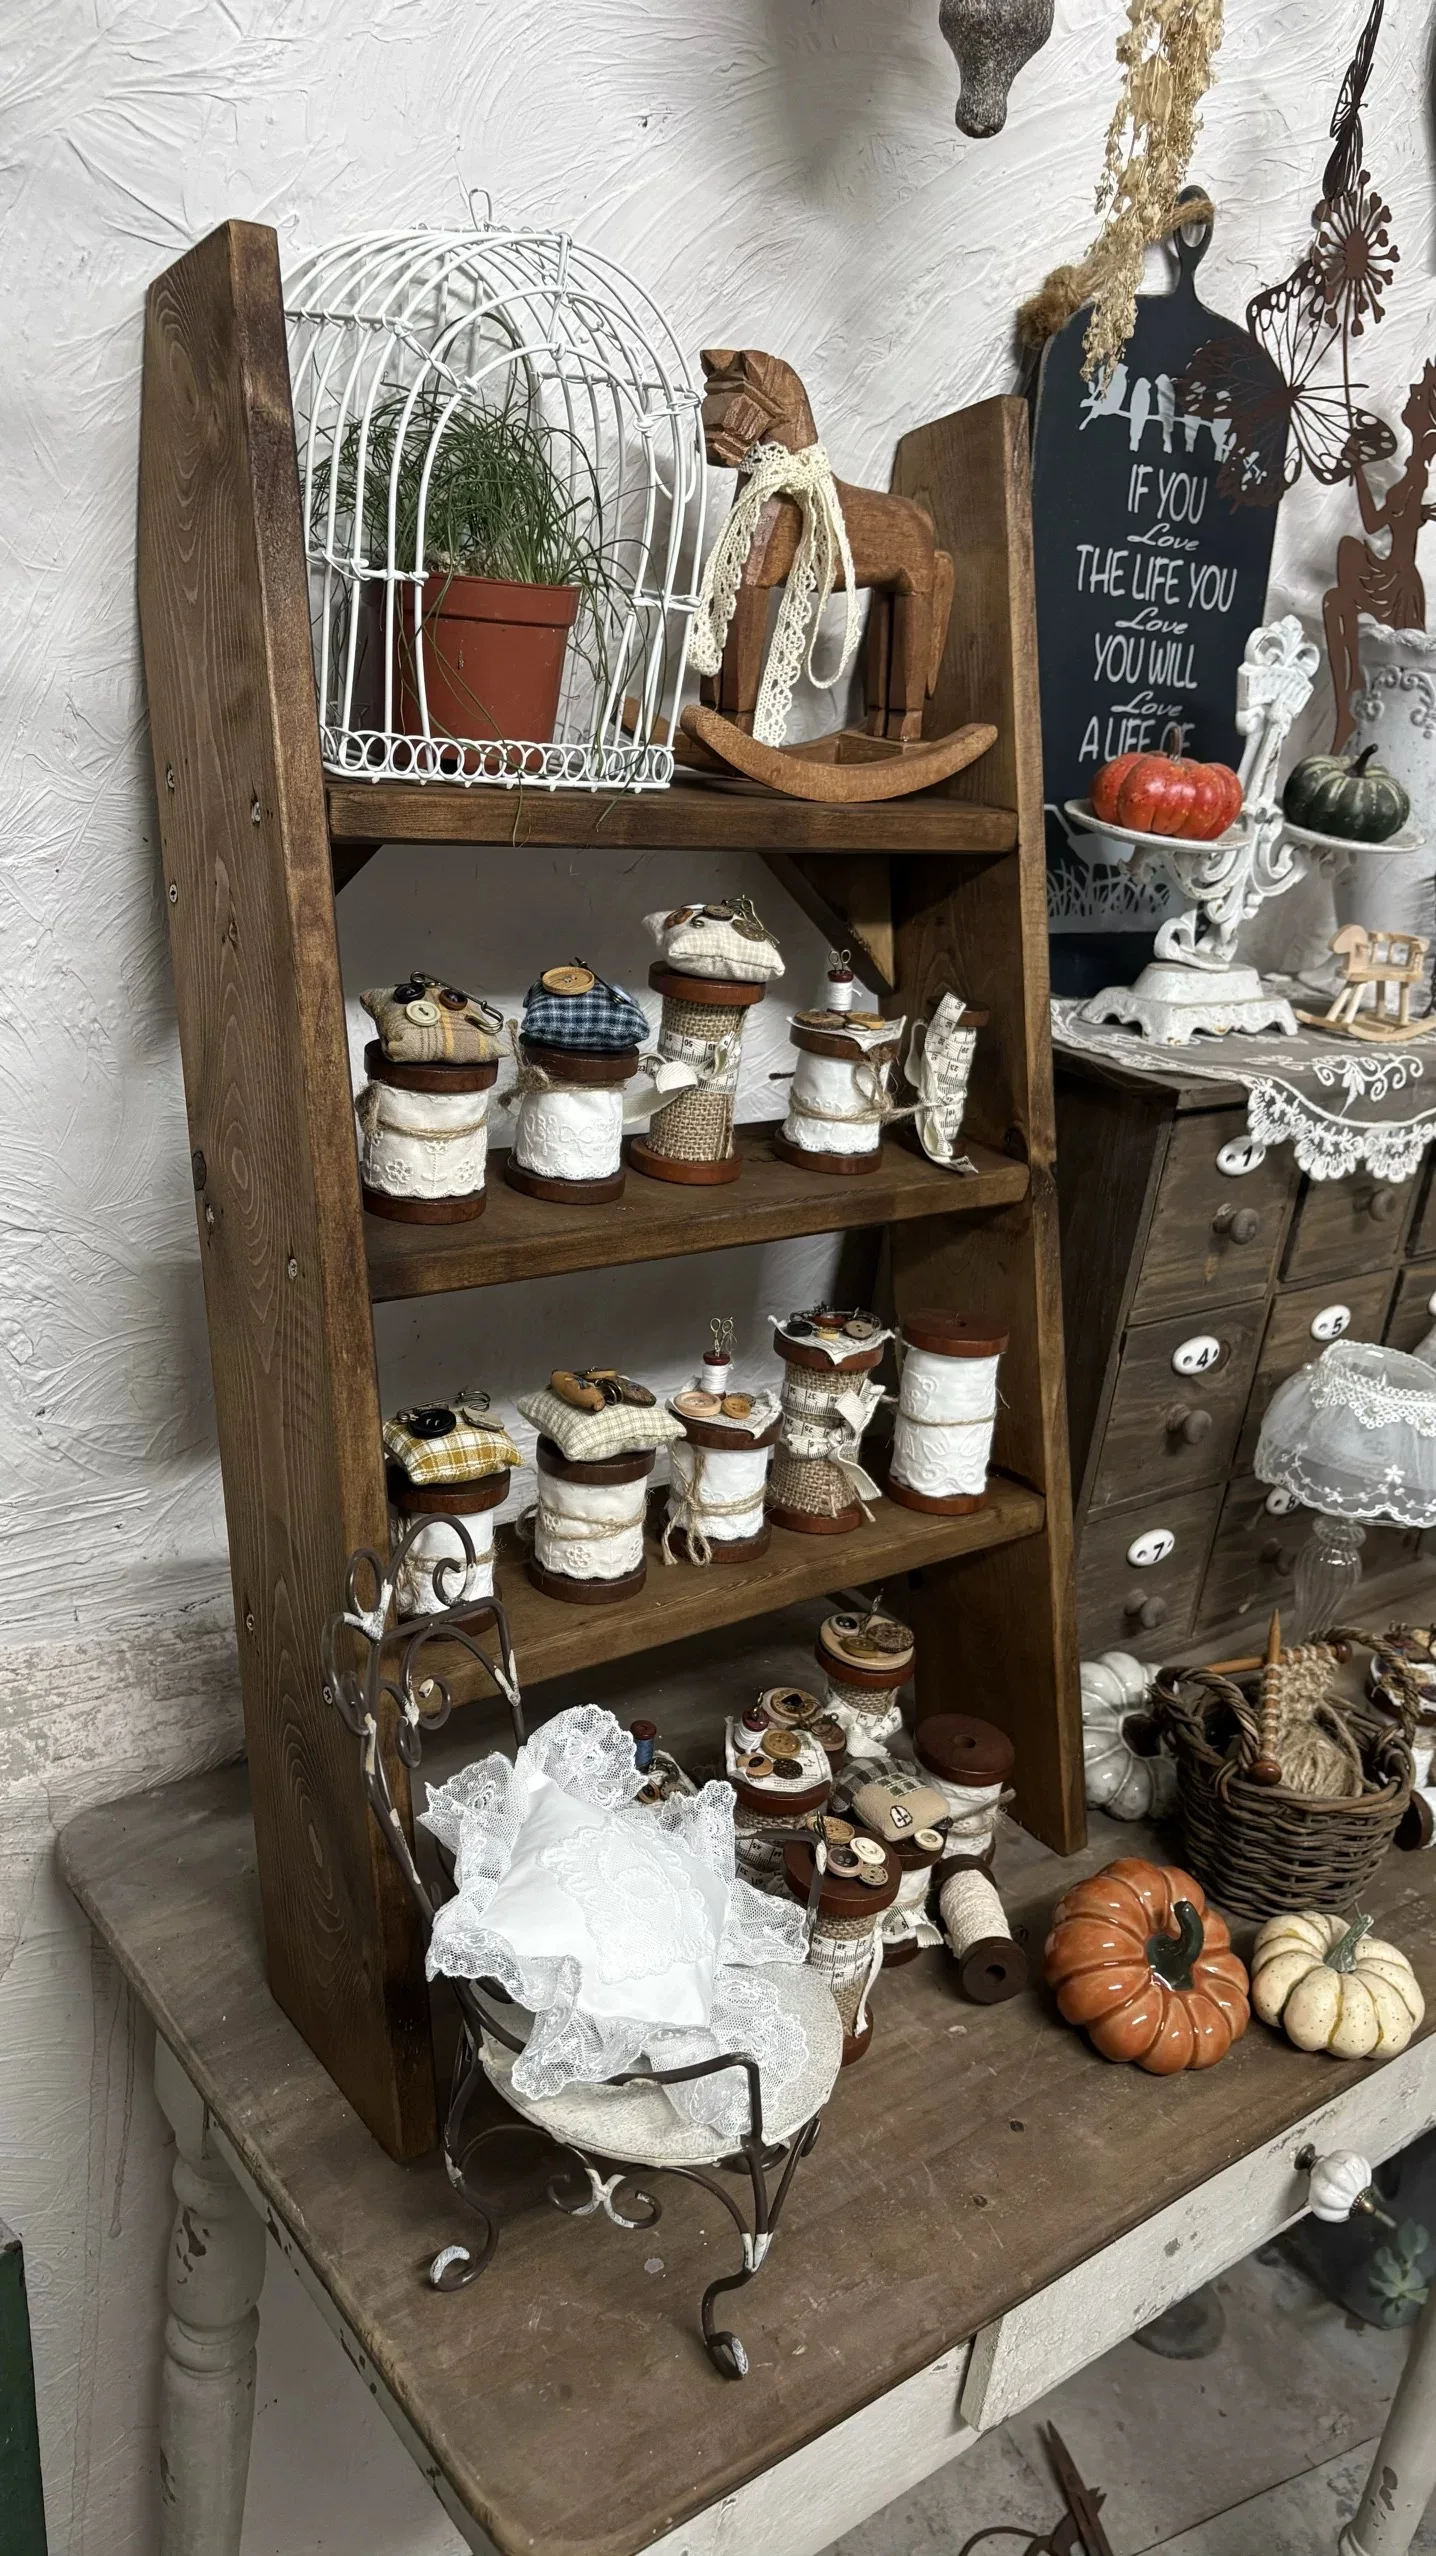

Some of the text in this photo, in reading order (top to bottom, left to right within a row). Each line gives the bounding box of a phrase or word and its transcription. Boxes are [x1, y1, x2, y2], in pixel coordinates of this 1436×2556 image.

[1128, 464, 1208, 524] IF YOU
[1126, 523, 1200, 551] Love
[1076, 544, 1238, 612] THE LIFE YOU
[1115, 607, 1189, 635] Love
[1094, 632, 1198, 689] YOU WILL
[1110, 691, 1183, 716] Love
[1078, 716, 1099, 763] A
[1104, 717, 1156, 762] LIFE
[1243, 1145, 1253, 1167] 1
[1331, 1316, 1343, 1336] 5
[1196, 1347, 1209, 1368] 4
[1285, 1494, 1297, 1511] 8
[1153, 1541, 1165, 1562] 7
